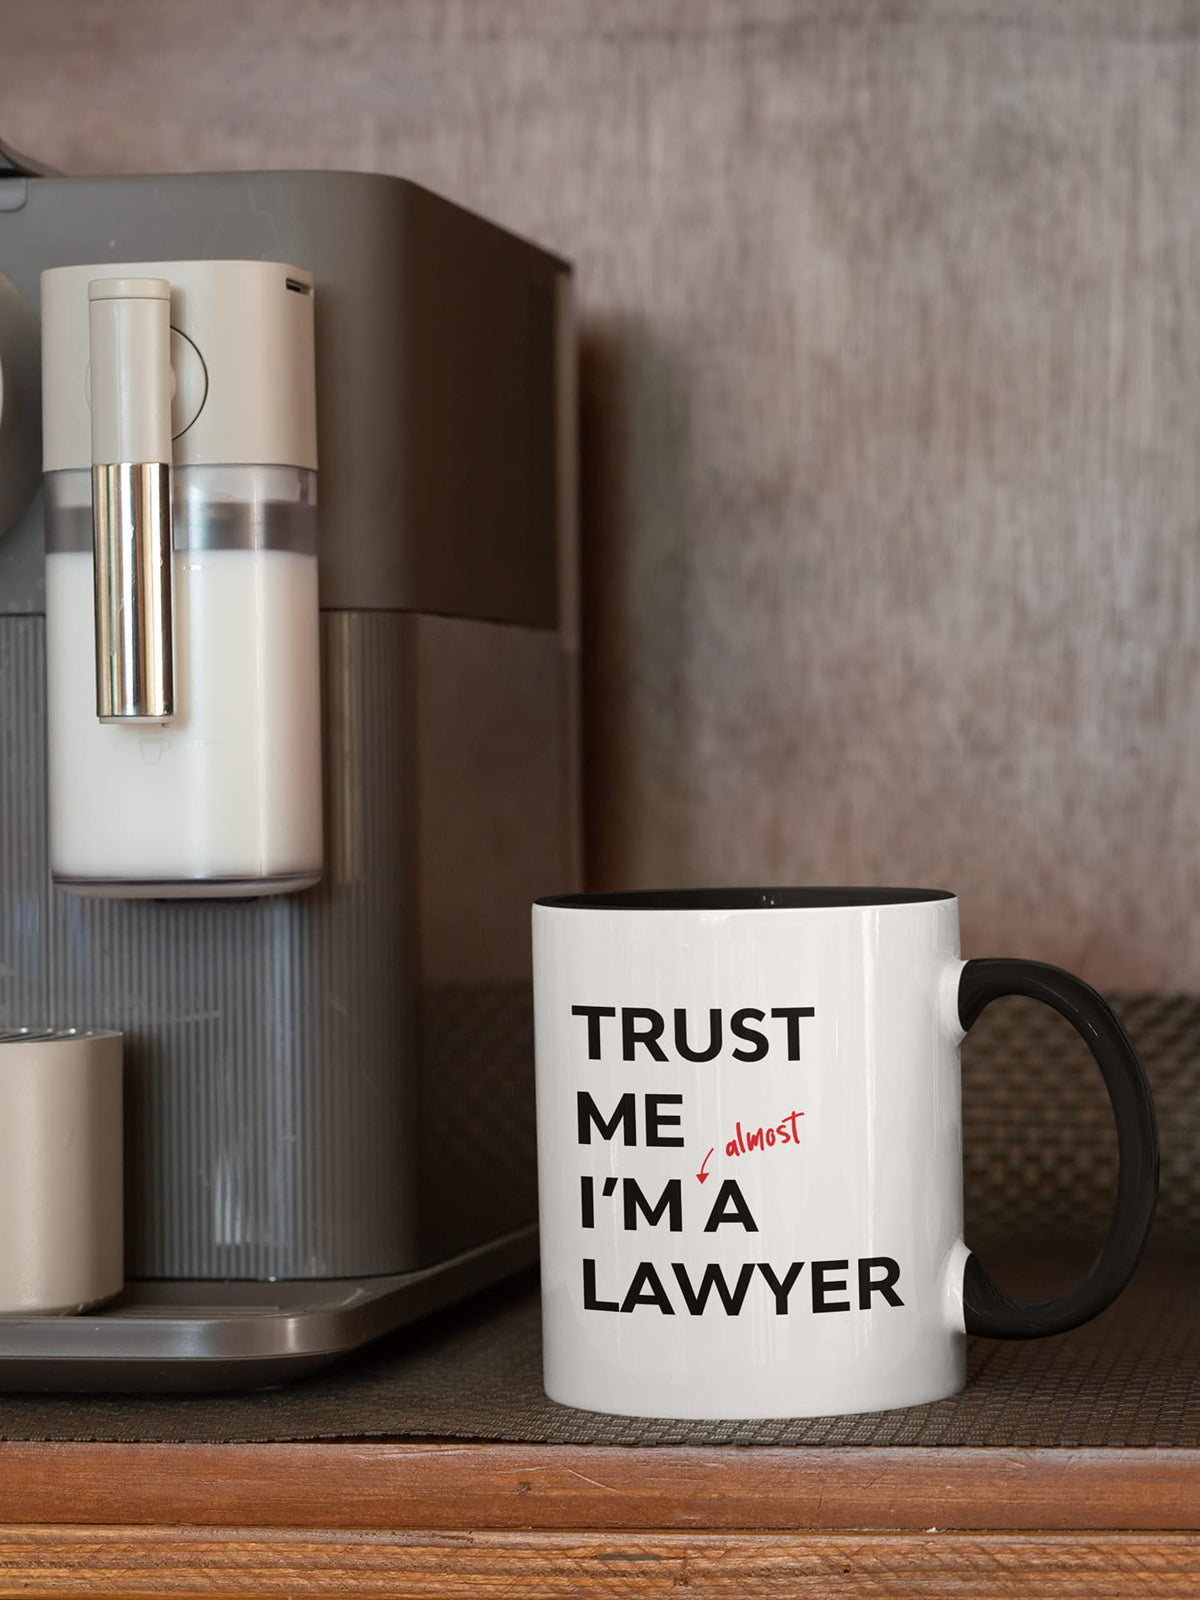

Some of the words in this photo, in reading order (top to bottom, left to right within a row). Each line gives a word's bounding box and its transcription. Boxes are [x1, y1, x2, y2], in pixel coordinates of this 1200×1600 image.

[572, 1005, 815, 1062] TRUST
[577, 1091, 684, 1147] ME
[725, 1111, 805, 1157] almost
[581, 1176, 682, 1232] I'M
[704, 1179, 758, 1232] A
[583, 1257, 905, 1316] LAWYER
